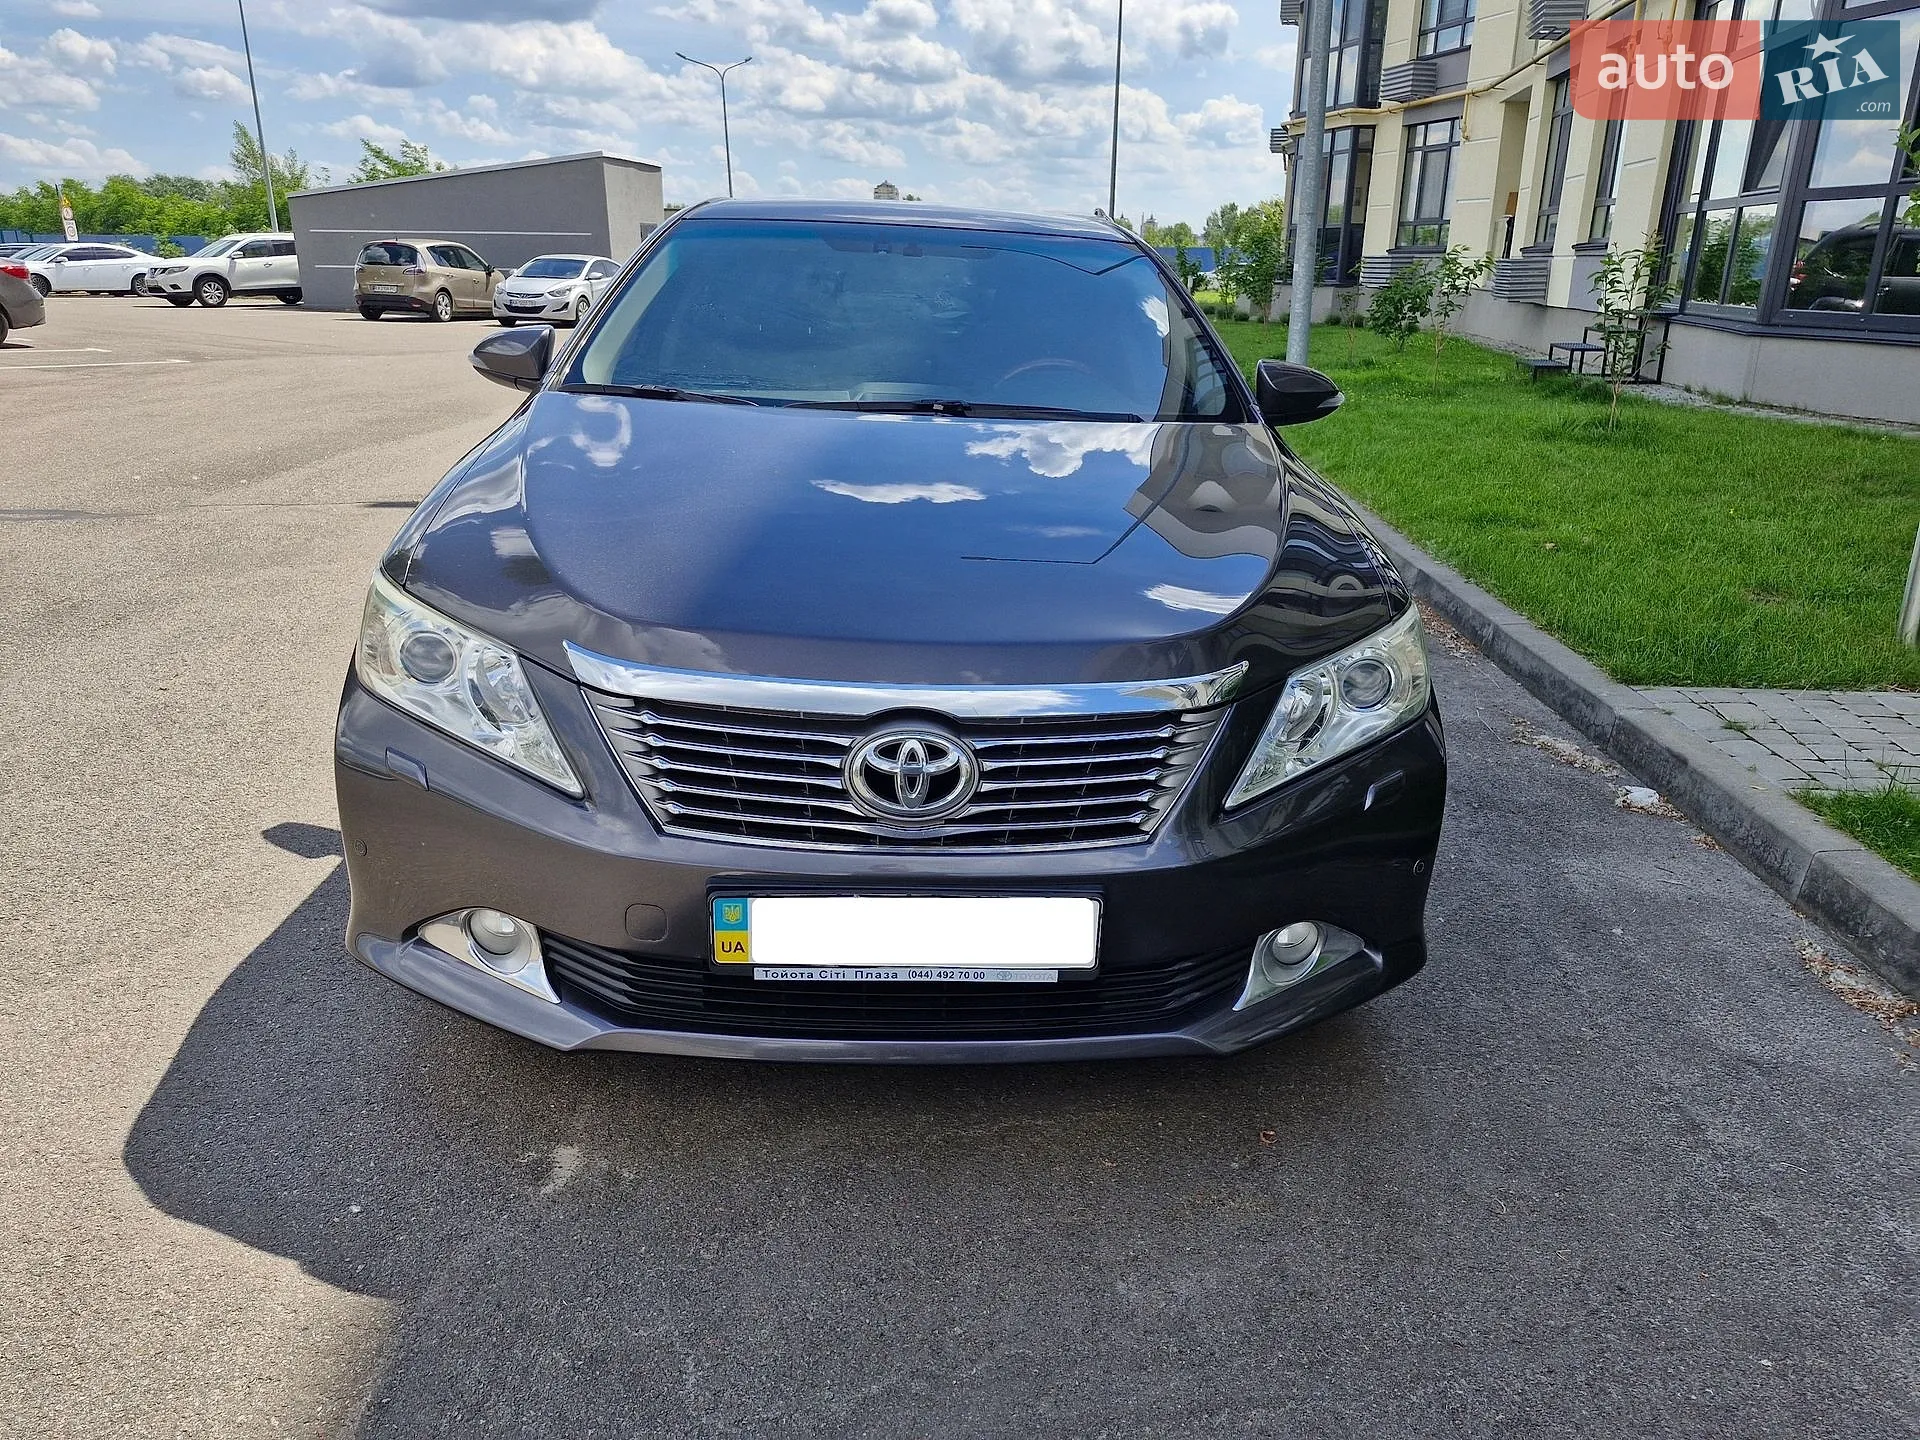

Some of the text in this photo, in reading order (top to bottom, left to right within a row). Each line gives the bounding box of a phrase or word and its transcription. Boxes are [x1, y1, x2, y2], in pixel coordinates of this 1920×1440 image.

[721, 940, 746, 954] UA
[762, 969, 985, 980] Тойота Сіті Плаза (044) 492 70 00
[1014, 971, 1055, 981] TOYOTA
